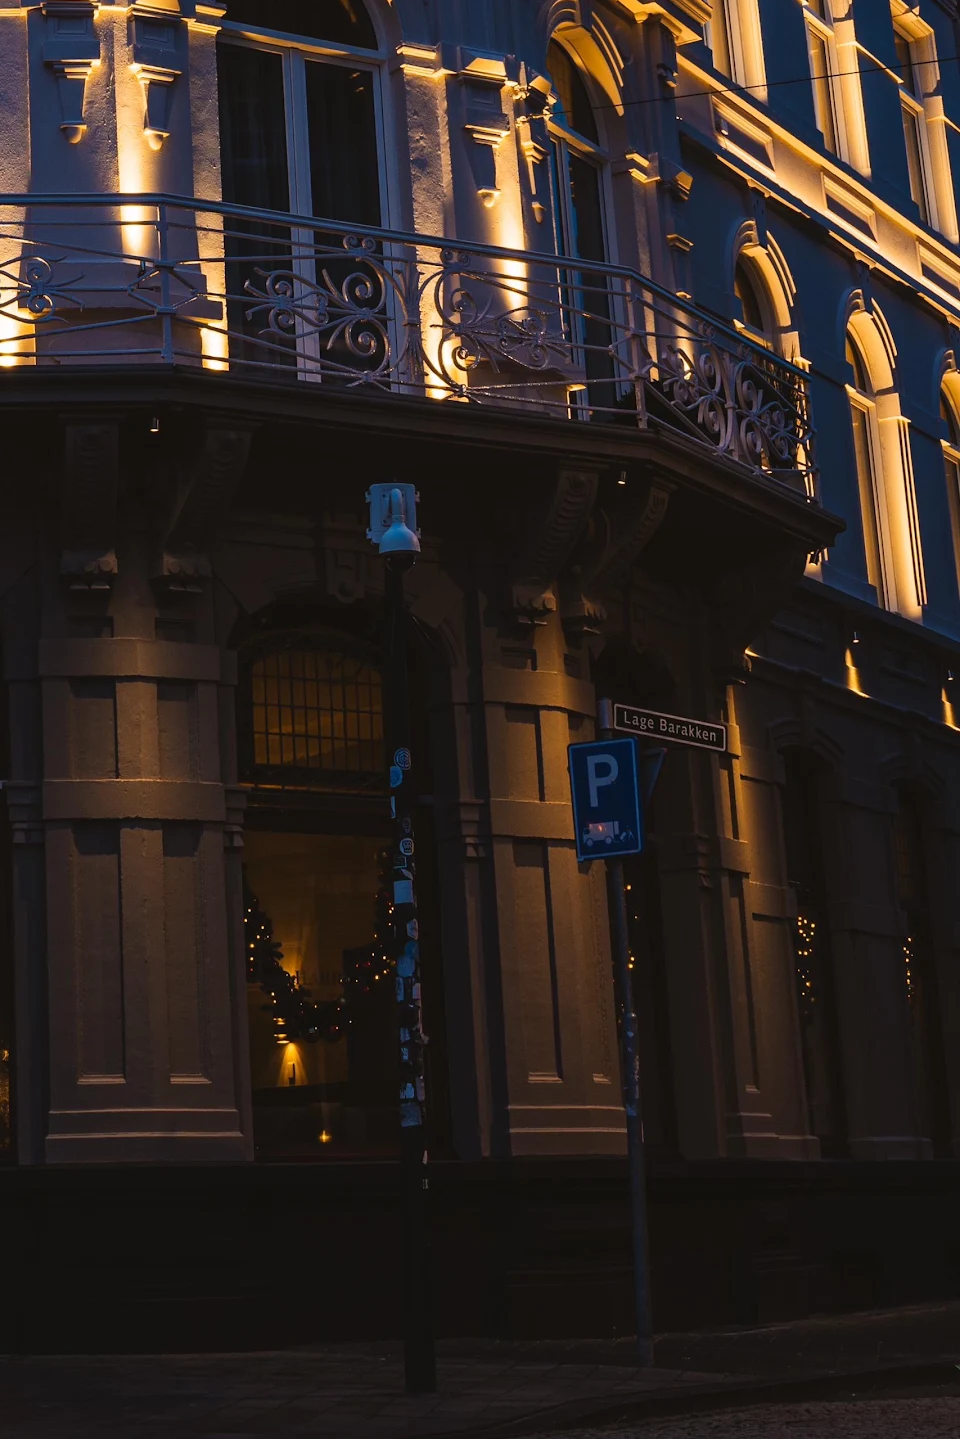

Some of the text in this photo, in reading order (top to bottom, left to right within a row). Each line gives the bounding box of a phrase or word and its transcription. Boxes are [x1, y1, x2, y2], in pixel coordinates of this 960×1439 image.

[626, 711, 717, 742] Lage Barakken
[586, 753, 619, 808] P
